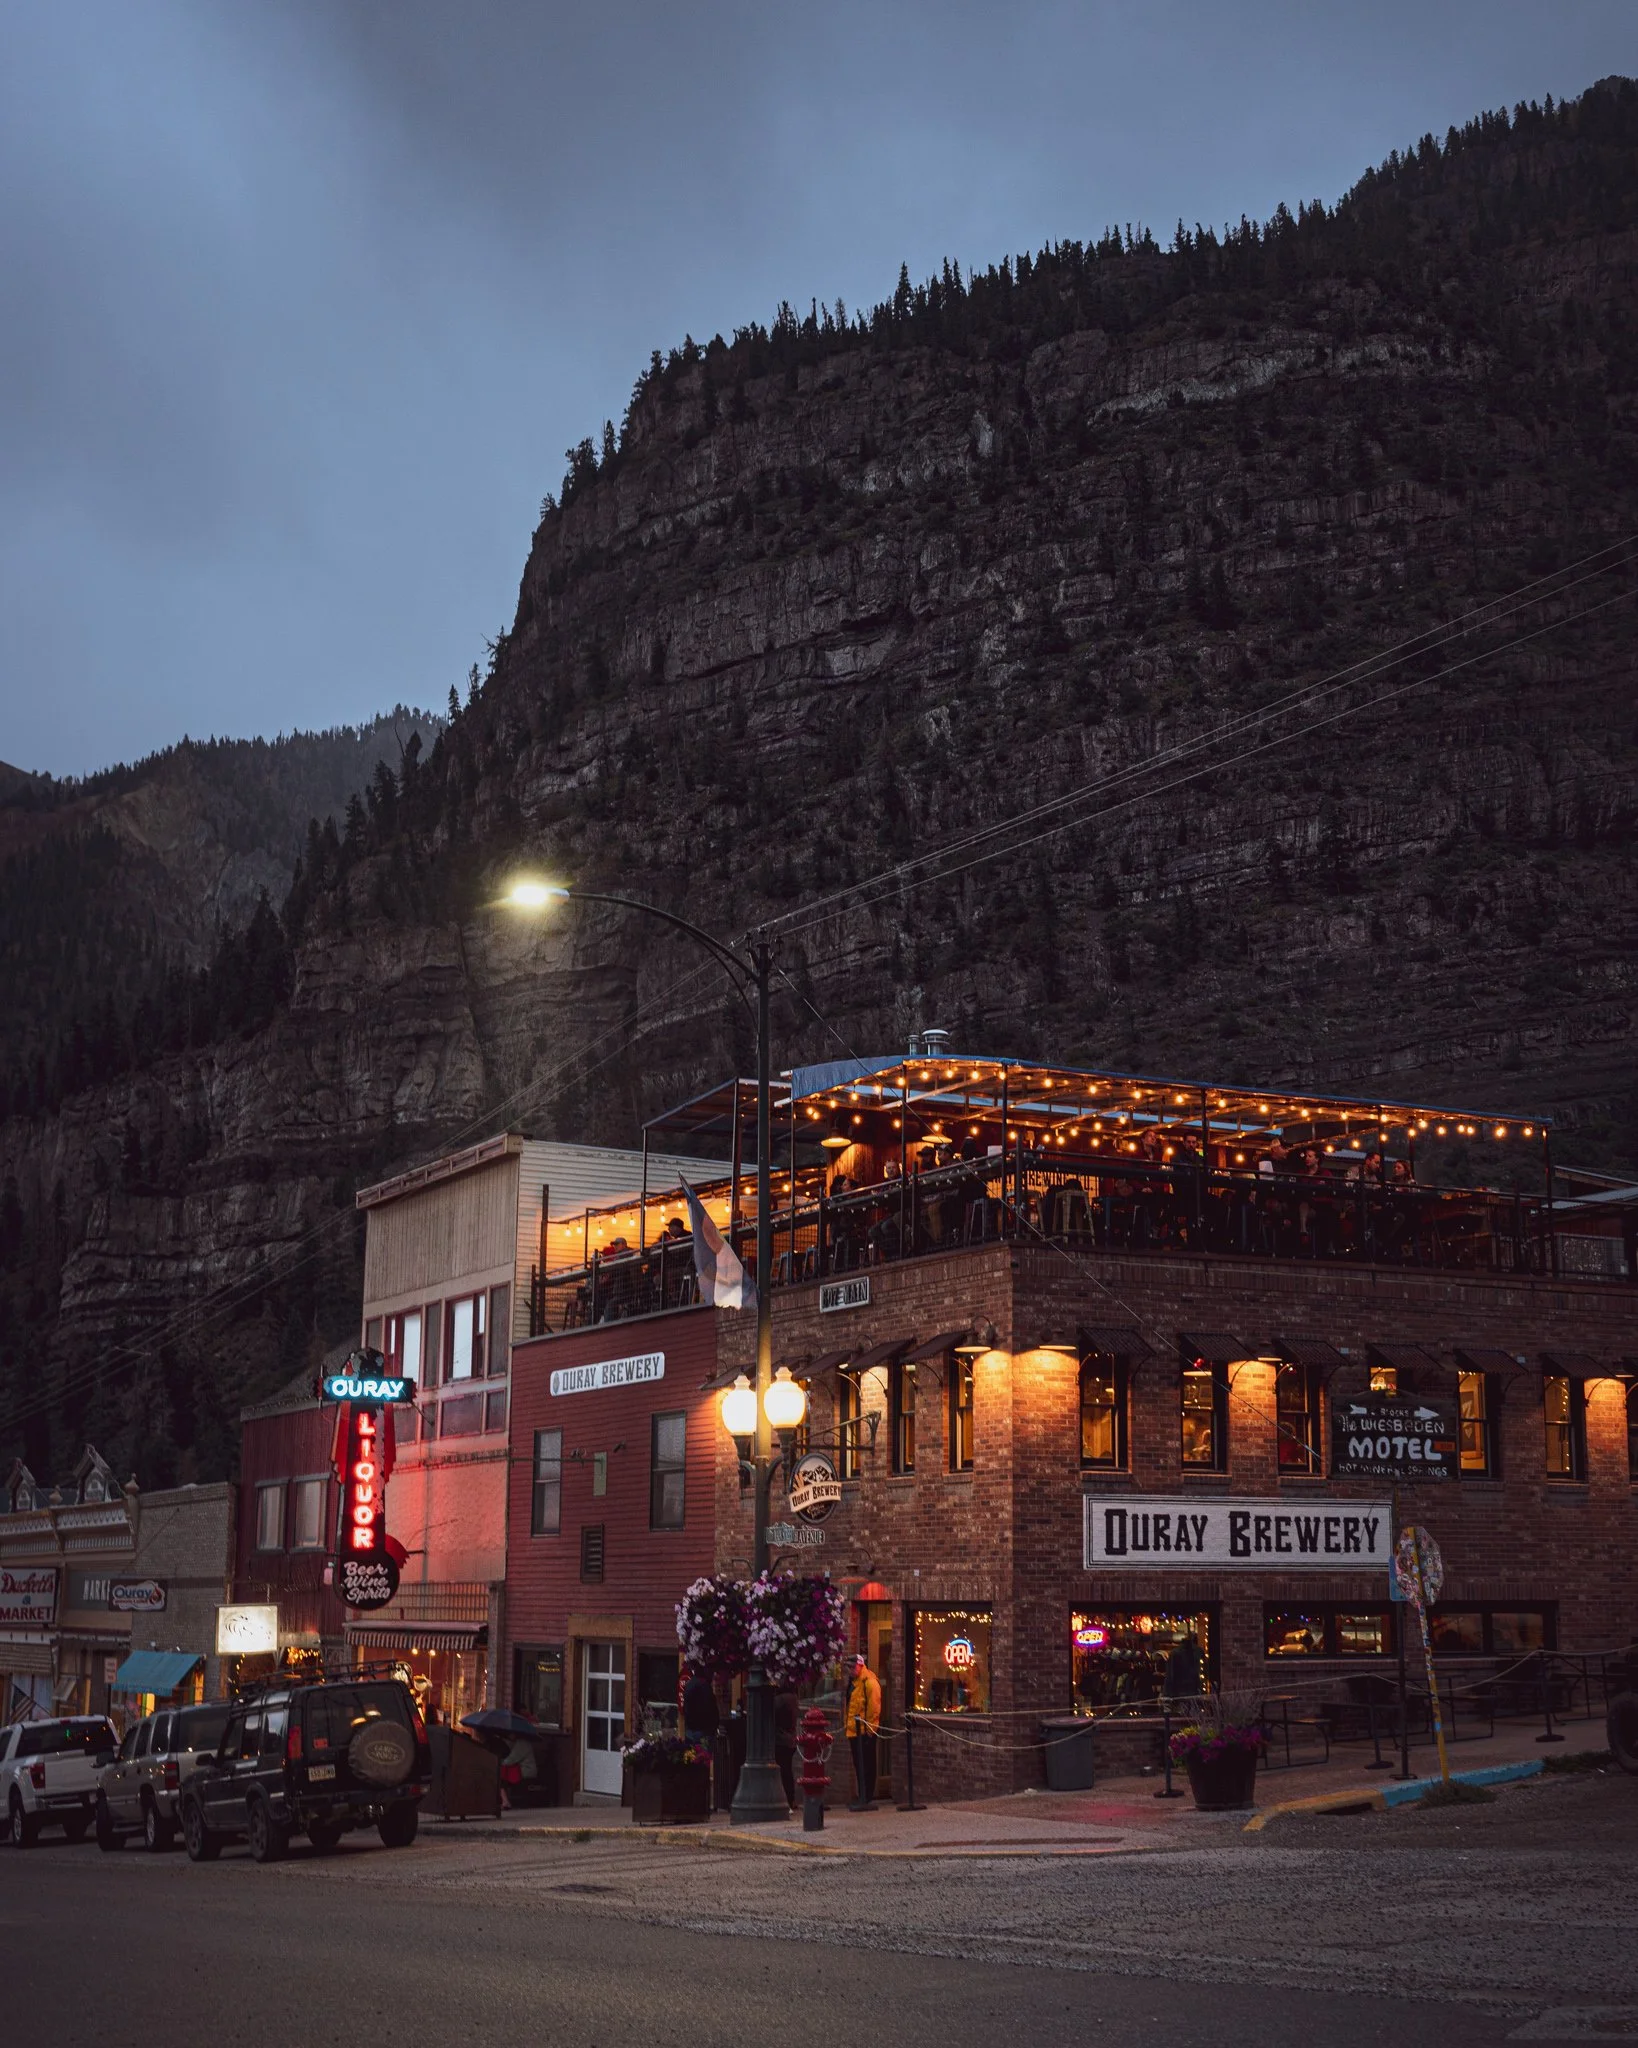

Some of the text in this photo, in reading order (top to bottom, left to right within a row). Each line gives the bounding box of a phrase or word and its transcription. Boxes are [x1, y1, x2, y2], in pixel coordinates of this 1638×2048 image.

[562, 1356, 660, 1391] OURAY BREWERY
[331, 1379, 404, 1398] OURAY
[1361, 1418, 1445, 1434] WIESBADEN
[1348, 1436, 1442, 1461] MOTEL
[1407, 1465, 1448, 1477] SPNGS
[353, 1412, 375, 1549] LIQUOR
[792, 1490, 810, 1507] OURAY
[798, 1530, 823, 1544] AVENUE
[1104, 1508, 1379, 1557] OURAY BREWERY
[344, 1561, 388, 1576] Beer
[344, 1575, 388, 1587] Wine
[114, 1586, 152, 1600] Ouray
[346, 1587, 391, 1604] Spirits
[0, 1606, 52, 1621] MARKET
[945, 1644, 970, 1664] OPEN
